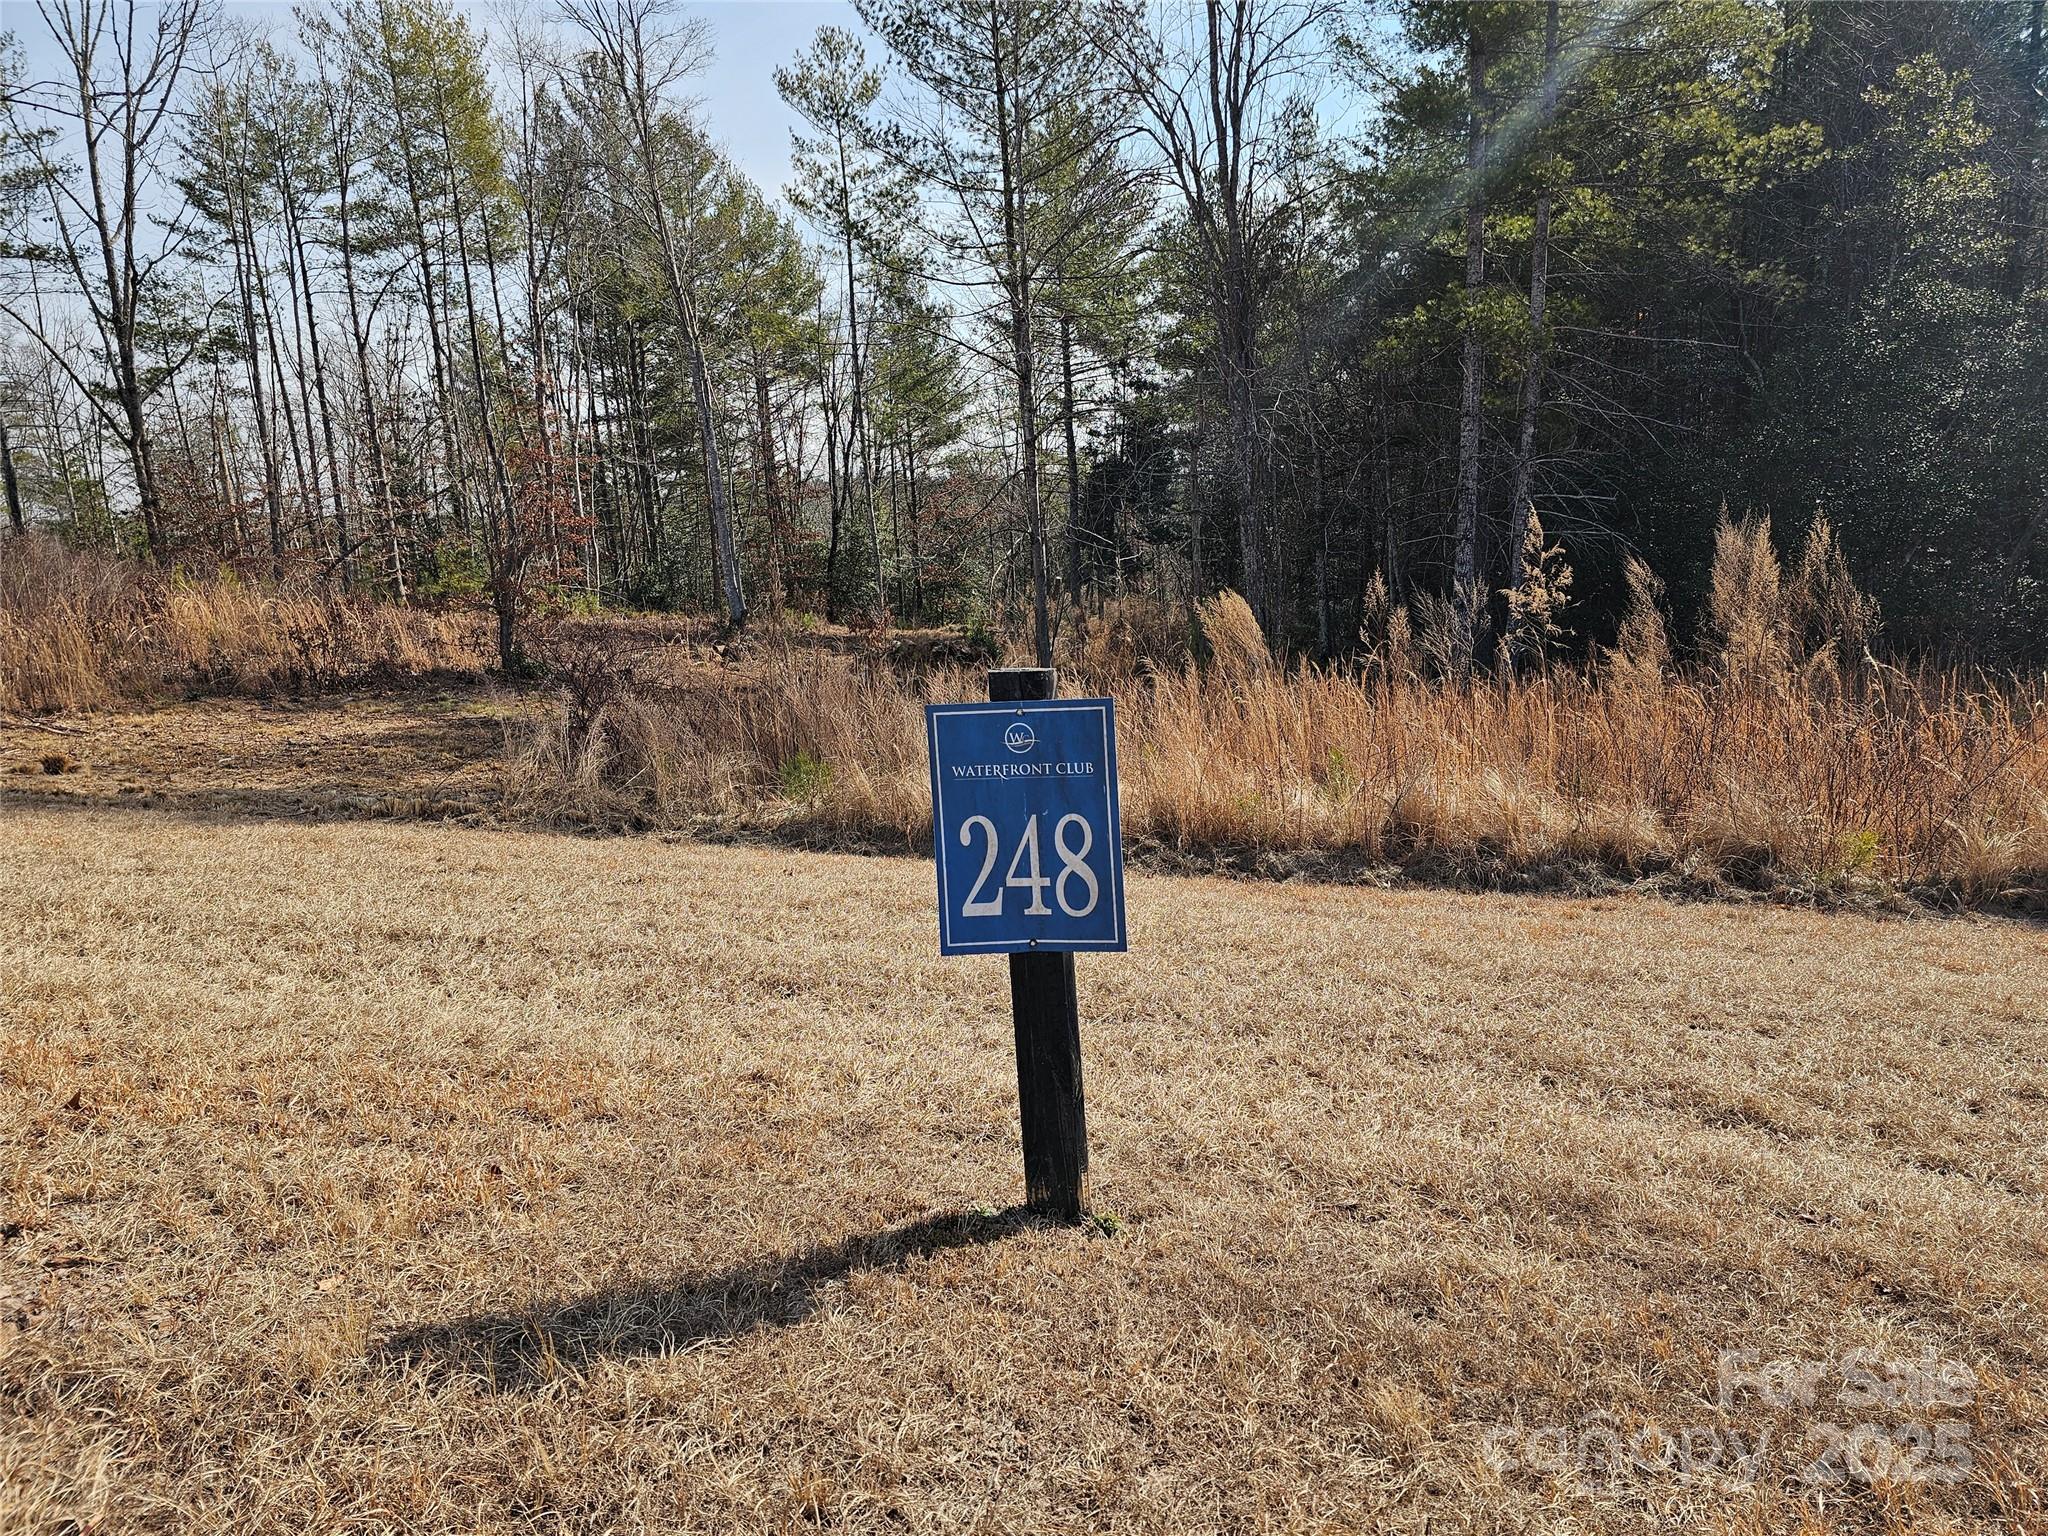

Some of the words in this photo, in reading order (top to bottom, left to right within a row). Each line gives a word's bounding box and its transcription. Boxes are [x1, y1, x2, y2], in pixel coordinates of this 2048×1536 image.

[952, 763, 1052, 780] WATERFRONT
[1055, 762, 1094, 775] CLUB
[959, 813, 1099, 918] 248
